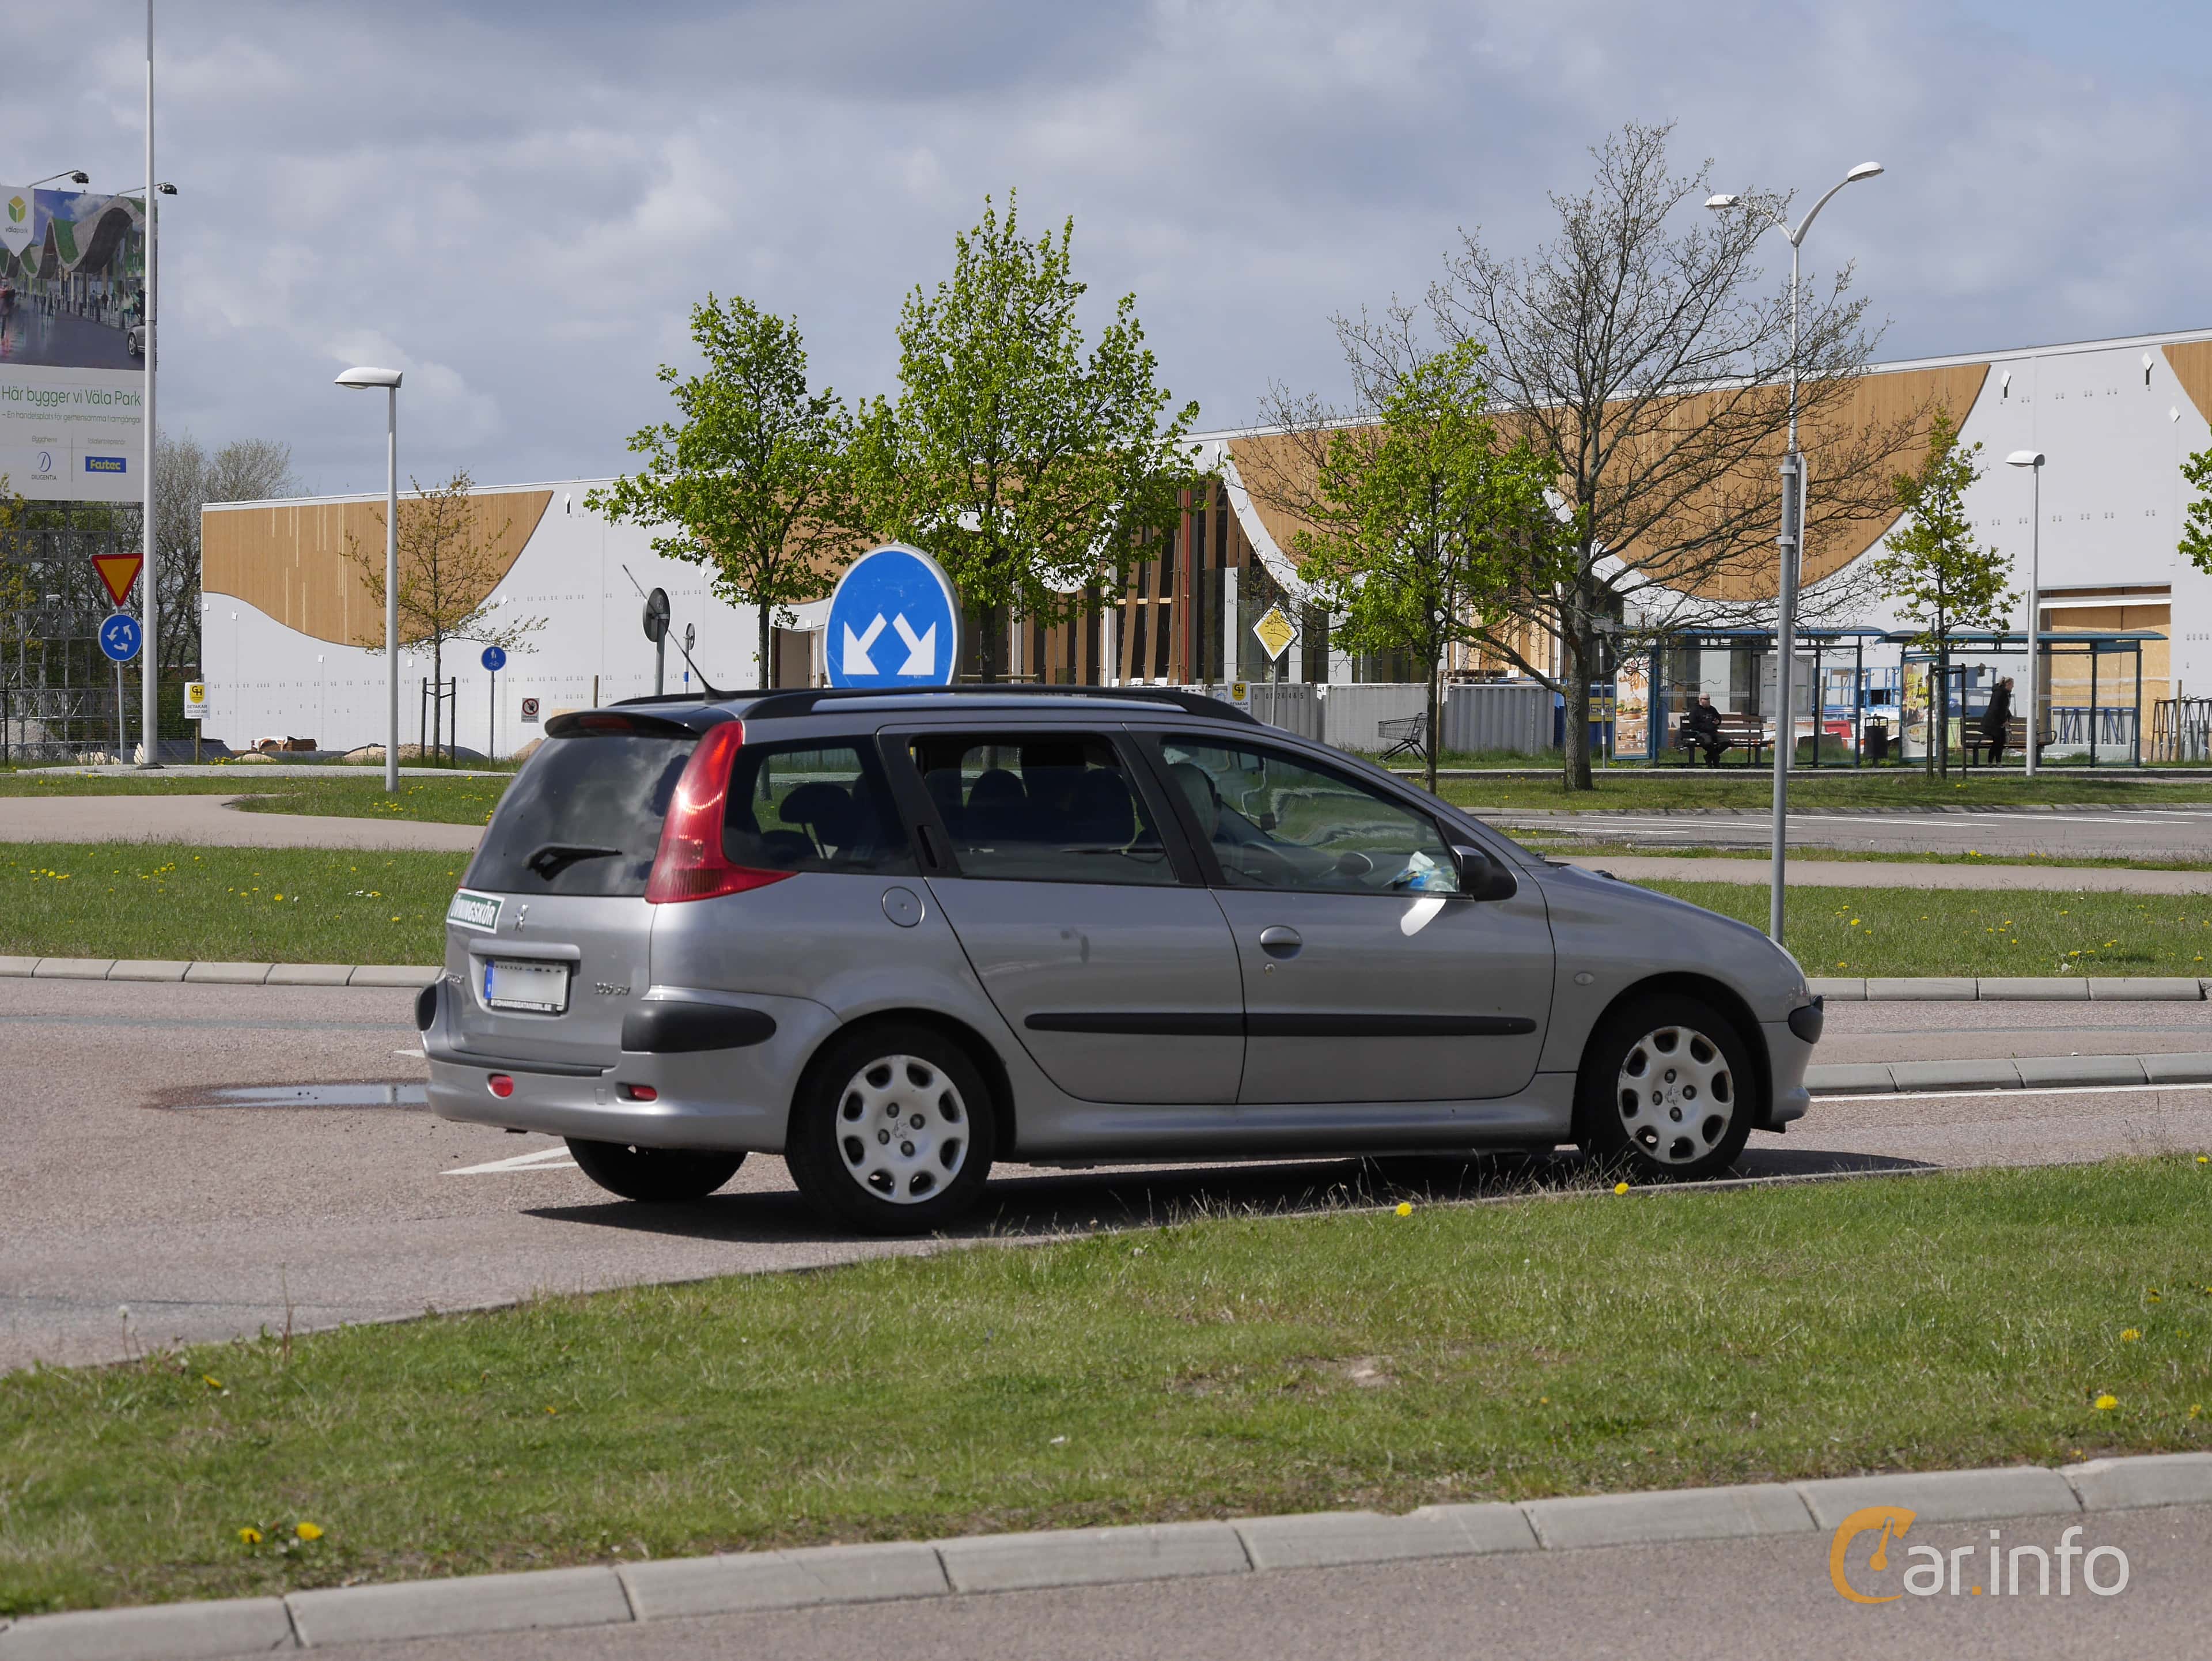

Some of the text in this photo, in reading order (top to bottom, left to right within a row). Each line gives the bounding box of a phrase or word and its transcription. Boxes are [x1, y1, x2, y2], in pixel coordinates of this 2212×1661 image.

[2, 385, 141, 407] Här bygger vi Väla Park
[90, 460, 121, 470] Fastec
